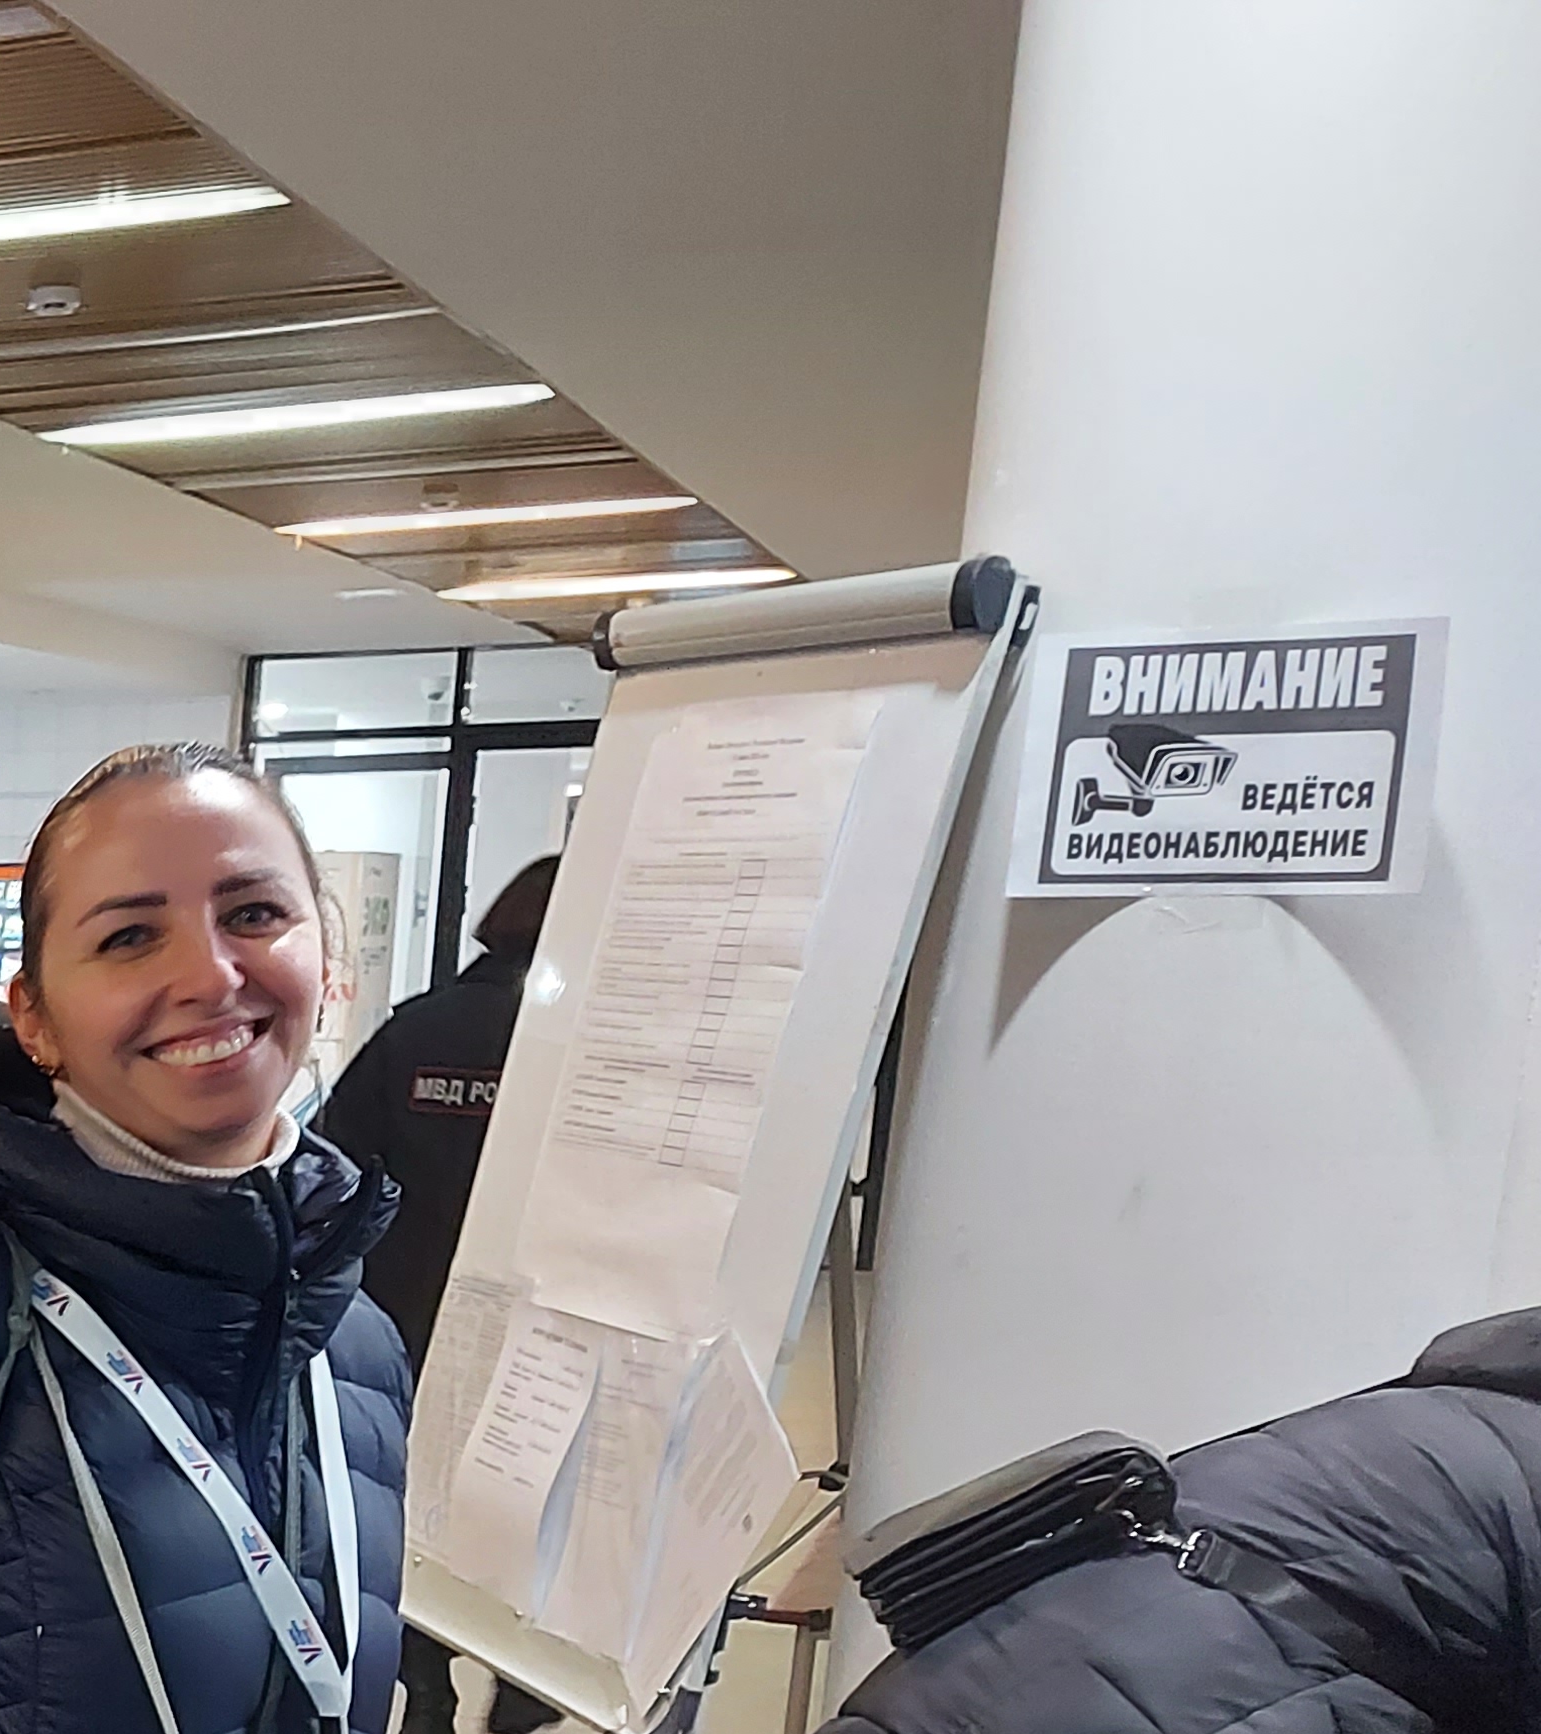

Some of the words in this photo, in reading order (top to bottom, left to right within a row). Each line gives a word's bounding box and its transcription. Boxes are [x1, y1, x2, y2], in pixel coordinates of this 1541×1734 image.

[1088, 645, 1389, 718] ВНИМАНИЕ
[1241, 776, 1375, 815] ВЕДЁТСЯ
[1066, 829, 1369, 865] ВИДЕОНАБЛЮДЕНИЕ
[413, 1076, 465, 1107] МВД
